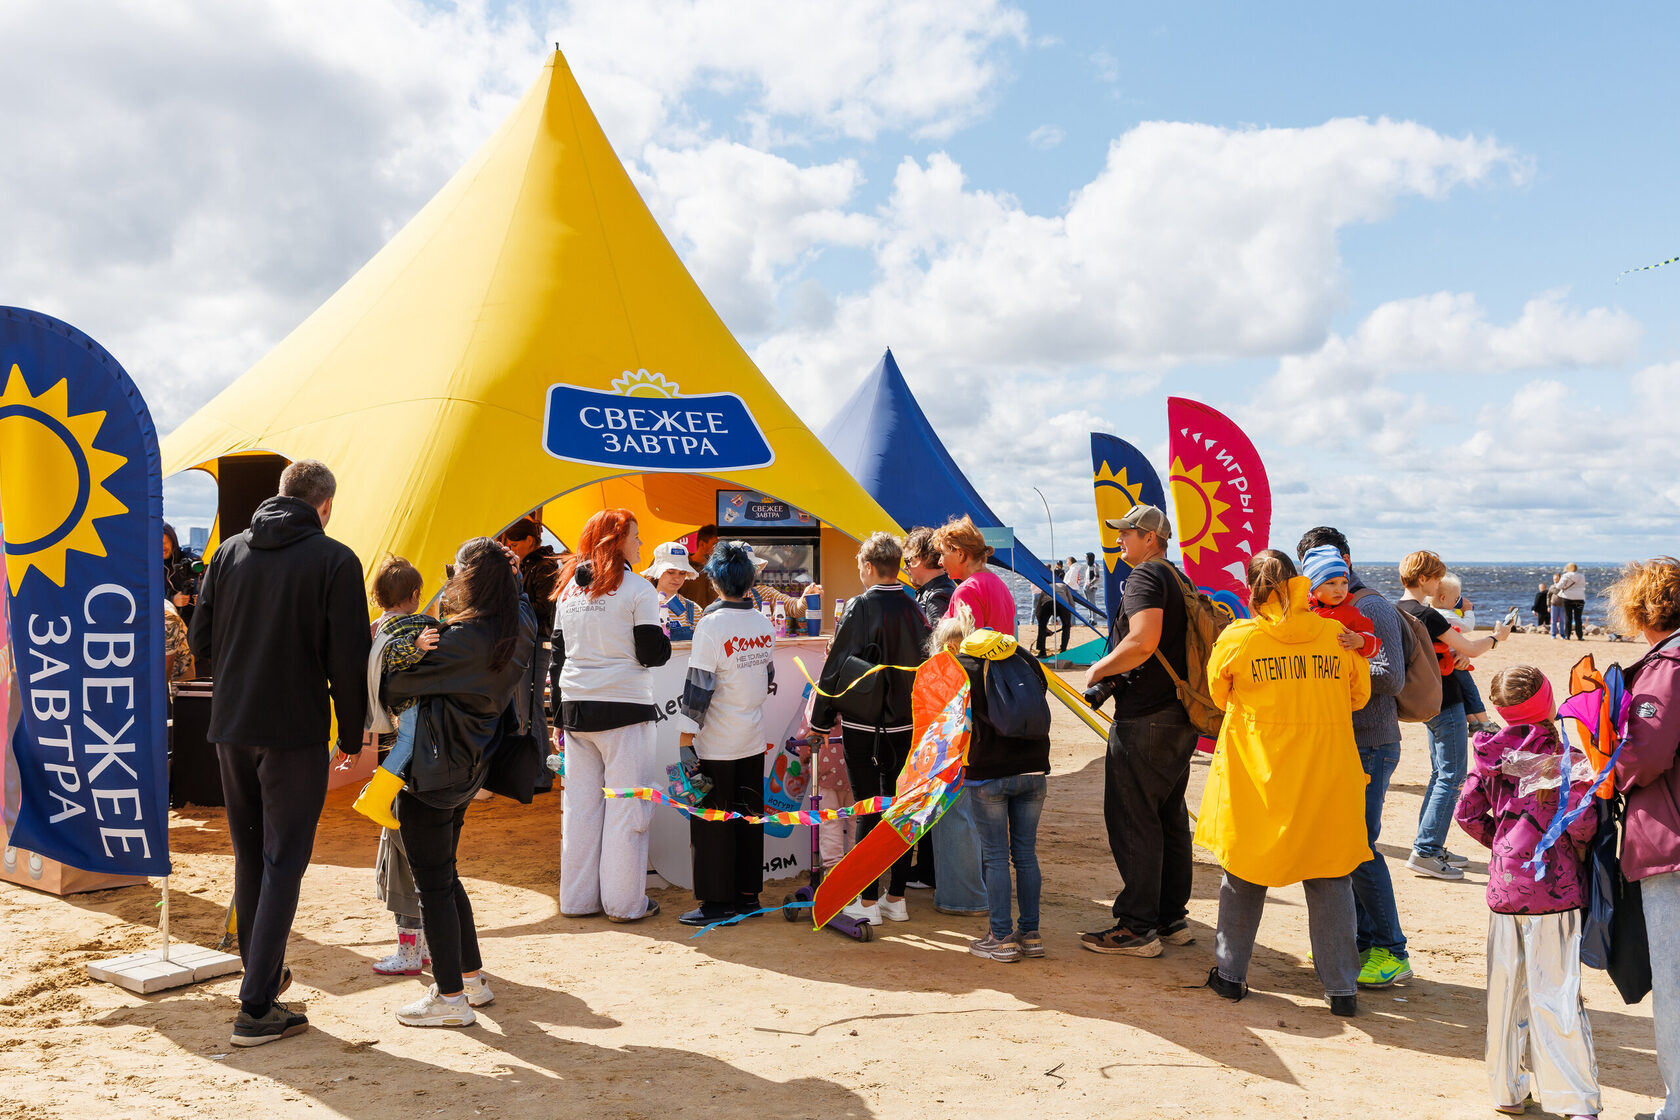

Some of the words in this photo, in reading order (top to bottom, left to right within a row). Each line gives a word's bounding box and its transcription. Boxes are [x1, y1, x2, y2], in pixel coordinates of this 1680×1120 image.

[579, 406, 728, 434] СВЕЖЕЕ
[601, 433, 719, 456] ЗАВТРА
[1216, 448, 1254, 514] ИГРЫ
[751, 505, 783, 513] СВЕЖЕЕ
[1251, 655, 1307, 683] ATTENTION
[28, 613, 87, 824] ЗАВТРА
[82, 583, 152, 859] СВЕЖЕЕ
